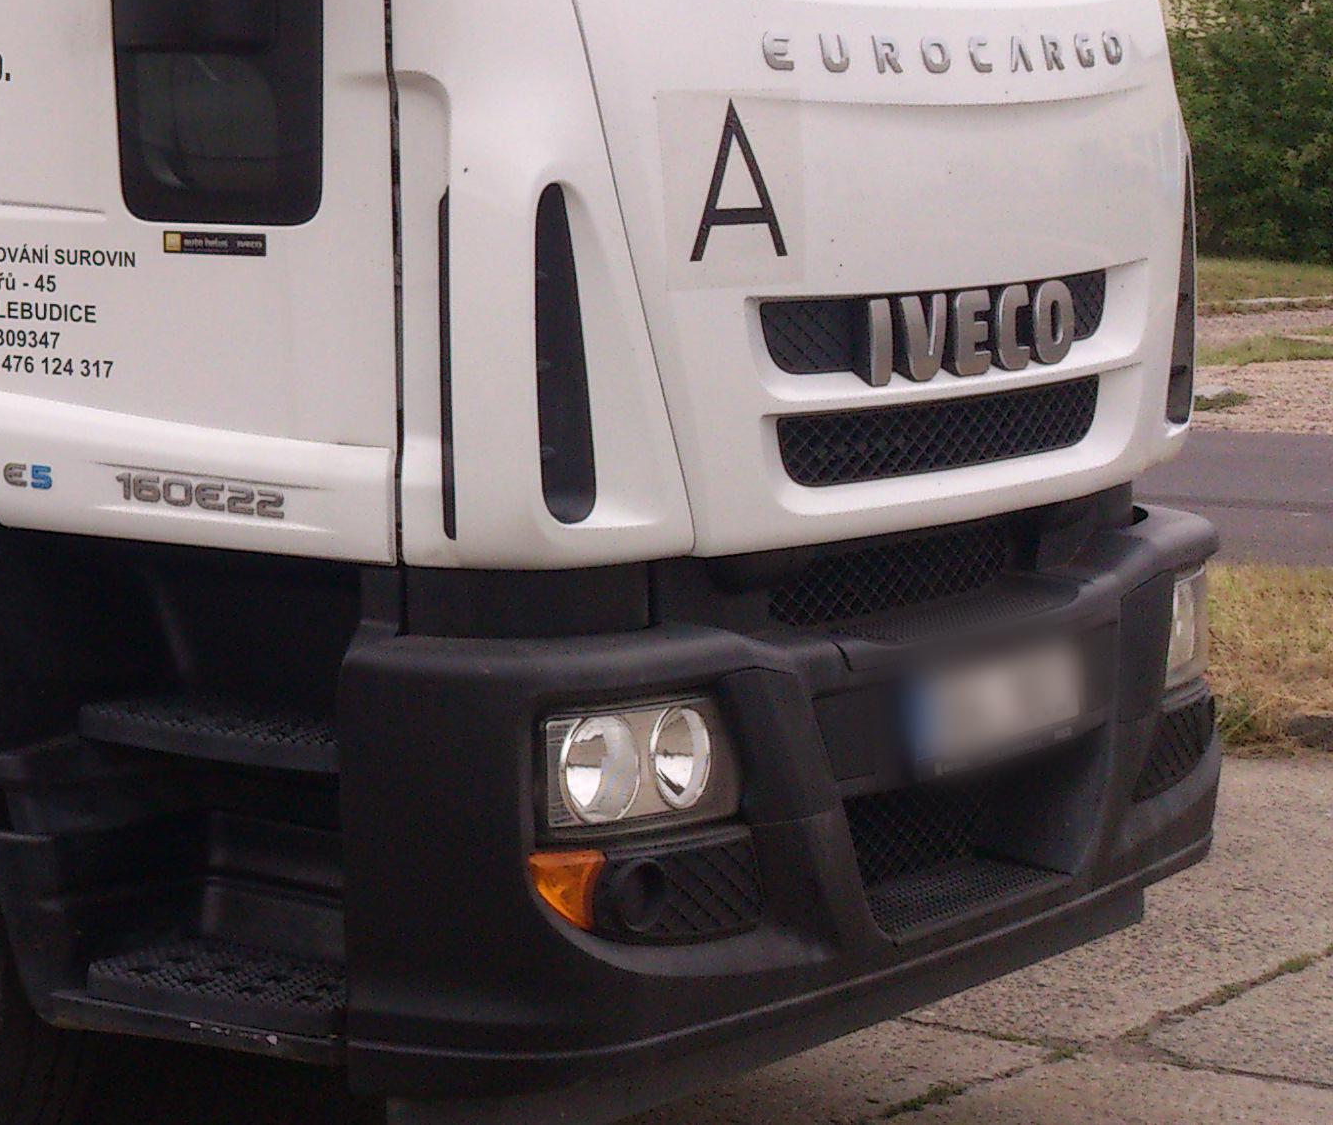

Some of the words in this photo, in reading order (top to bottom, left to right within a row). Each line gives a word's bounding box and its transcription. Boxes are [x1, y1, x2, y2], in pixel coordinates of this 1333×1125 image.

[762, 29, 1124, 75] EUROCARGO
[690, 98, 788, 262] A
[54, 249, 136, 267] SUROVIN
[35, 274, 56, 292] 45
[866, 279, 1075, 387] IVECO
[2, 355, 34, 373] 476
[41, 357, 73, 375] 124
[80, 360, 114, 378] 317
[116, 472, 285, 520] 160E22
